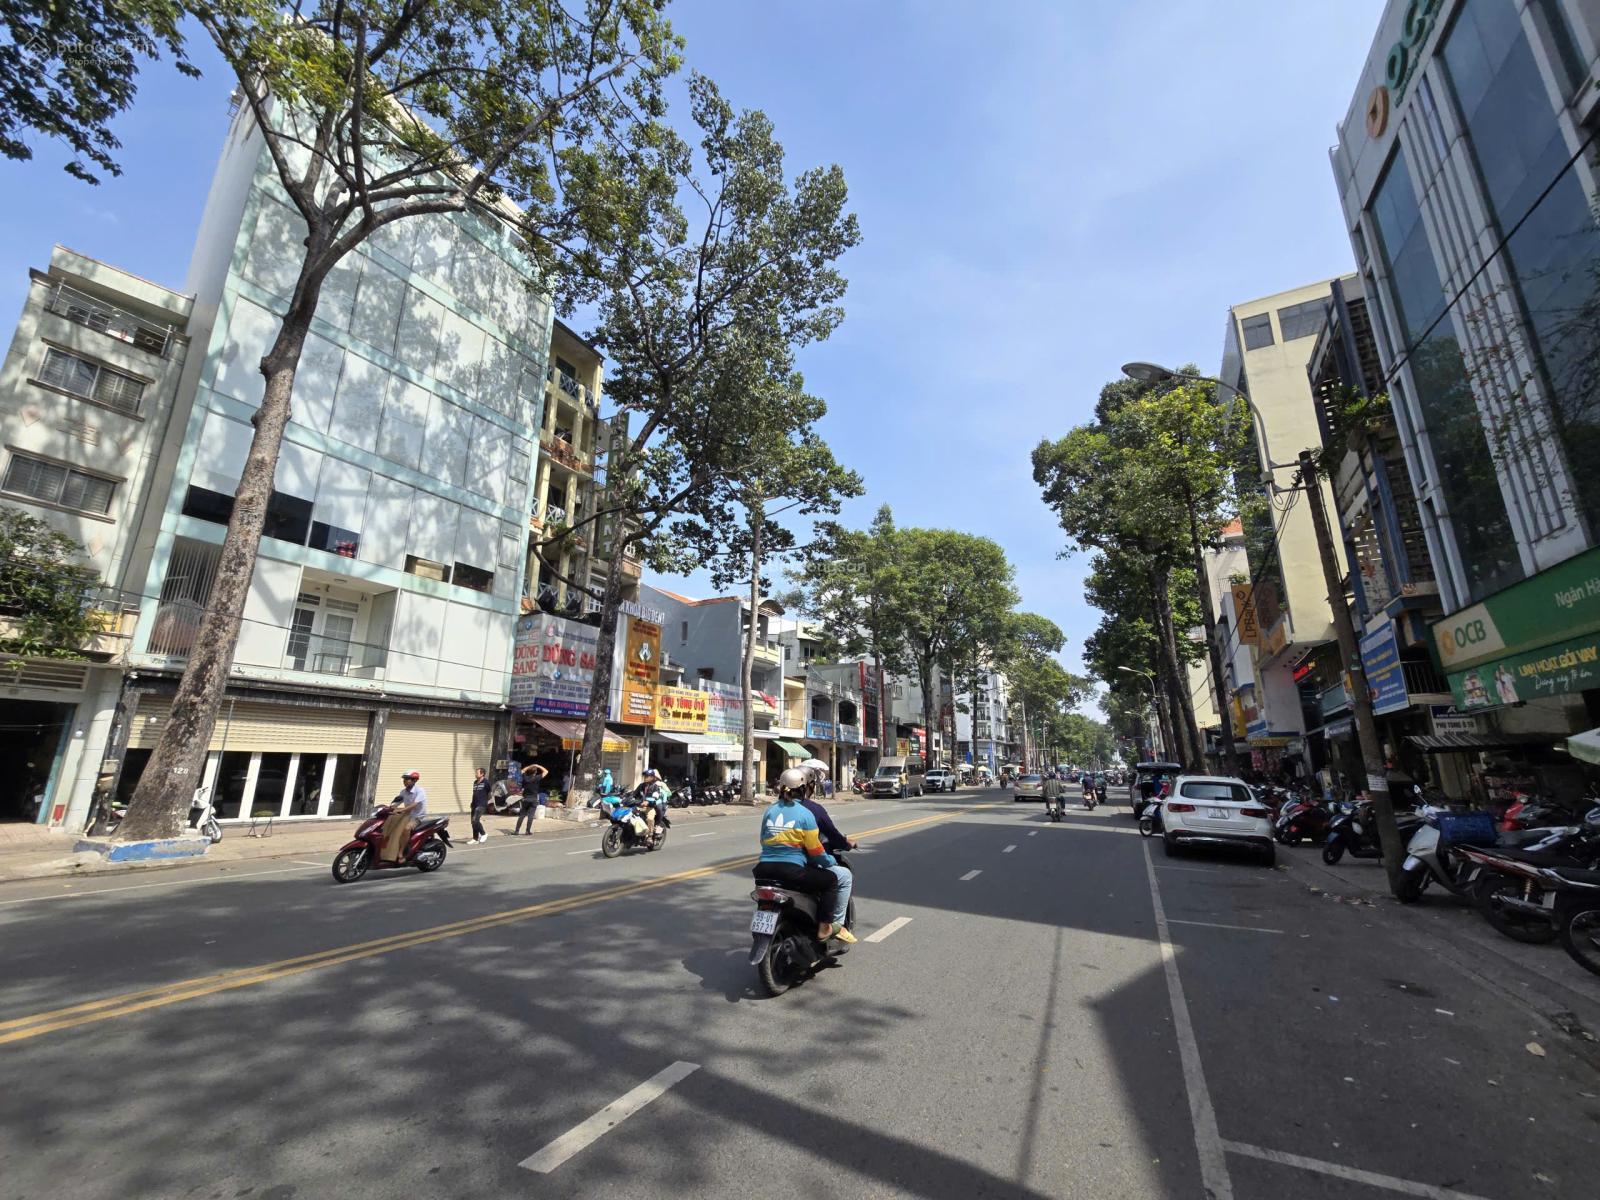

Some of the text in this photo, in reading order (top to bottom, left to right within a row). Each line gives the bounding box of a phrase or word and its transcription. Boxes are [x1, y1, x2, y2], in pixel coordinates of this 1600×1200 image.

[1554, 586, 1585, 608] Ngân
[1454, 619, 1487, 648] OCB
[542, 643, 577, 667] DŨNG
[1576, 645, 1598, 663] VAY
